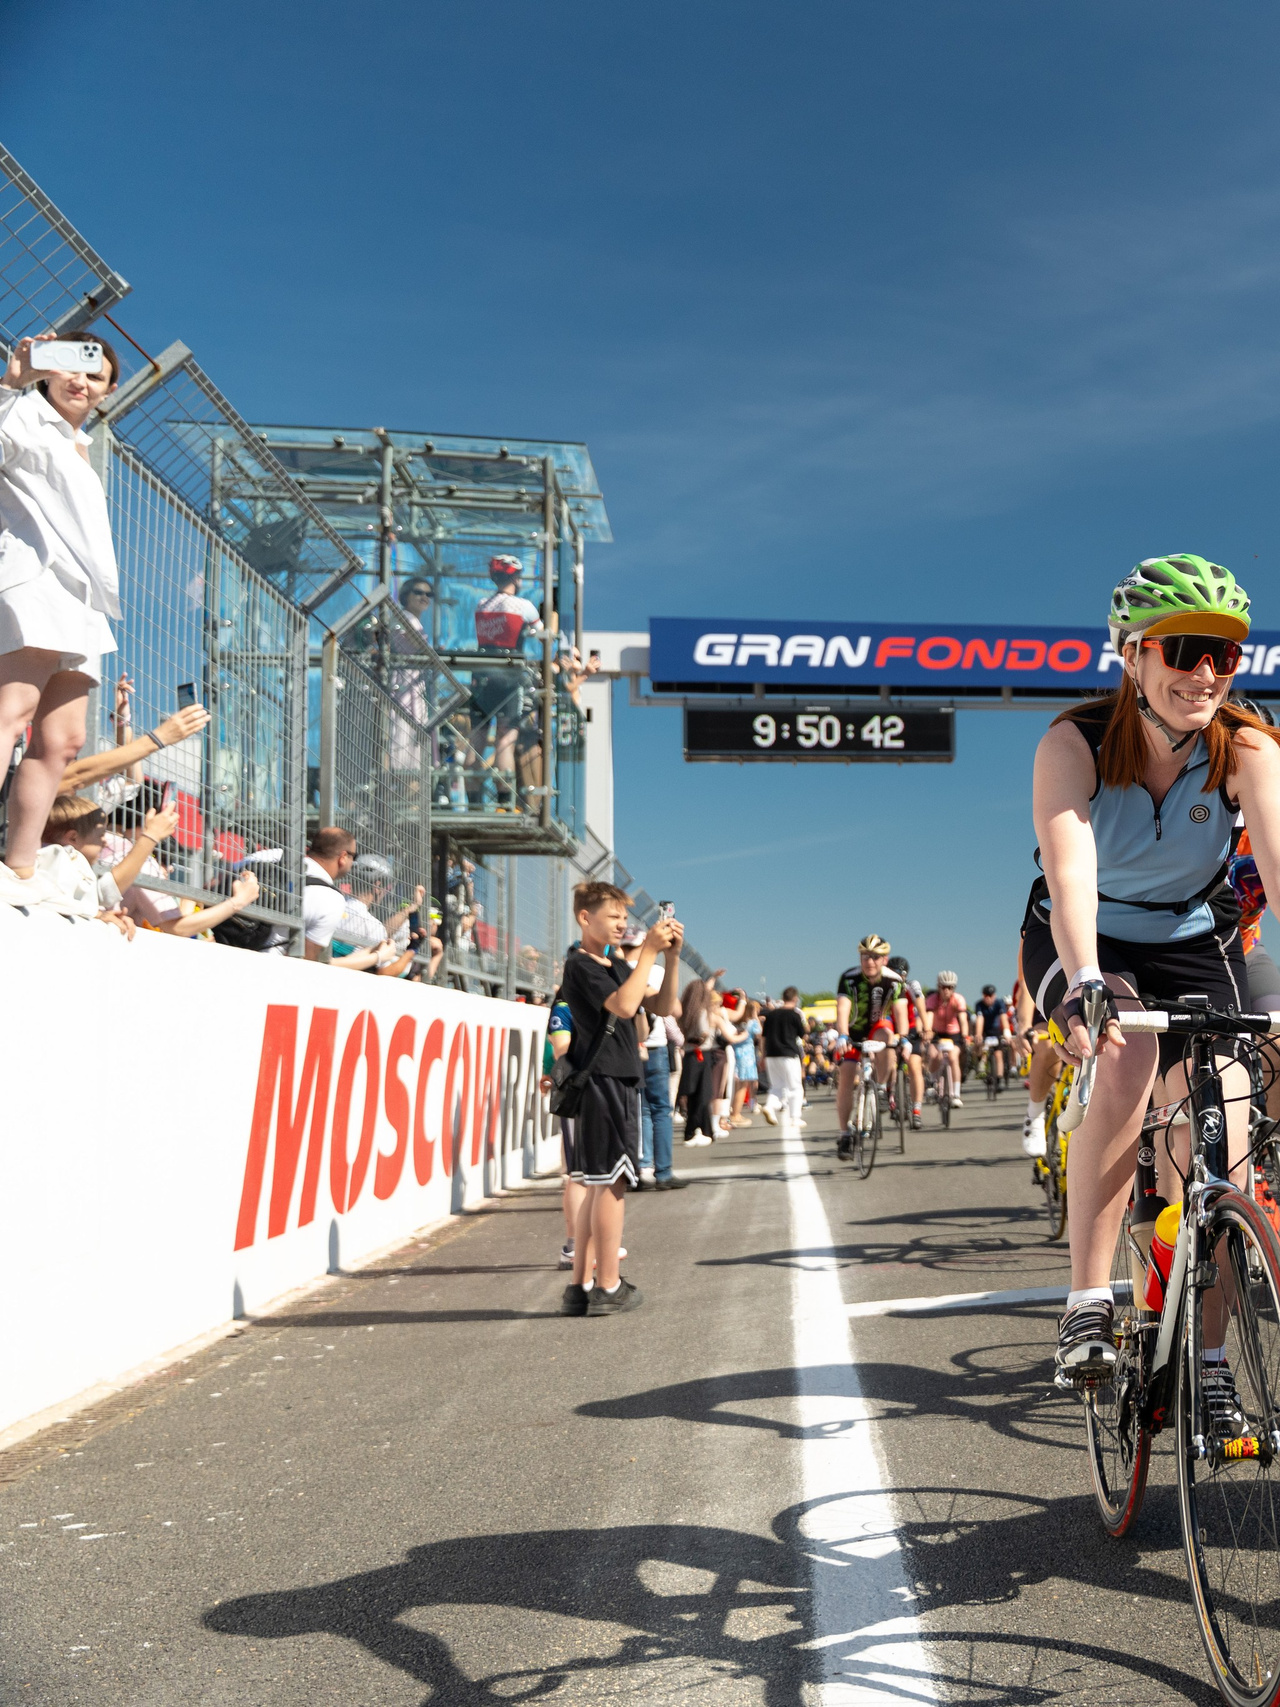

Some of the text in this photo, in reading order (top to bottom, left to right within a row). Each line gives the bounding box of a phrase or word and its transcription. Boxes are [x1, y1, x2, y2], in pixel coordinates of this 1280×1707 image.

[693, 633, 872, 668] GRAN
[874, 636, 1092, 673] FONDO
[752, 714, 905, 749] 9:50:42
[233, 1003, 507, 1252] MOSCOW
